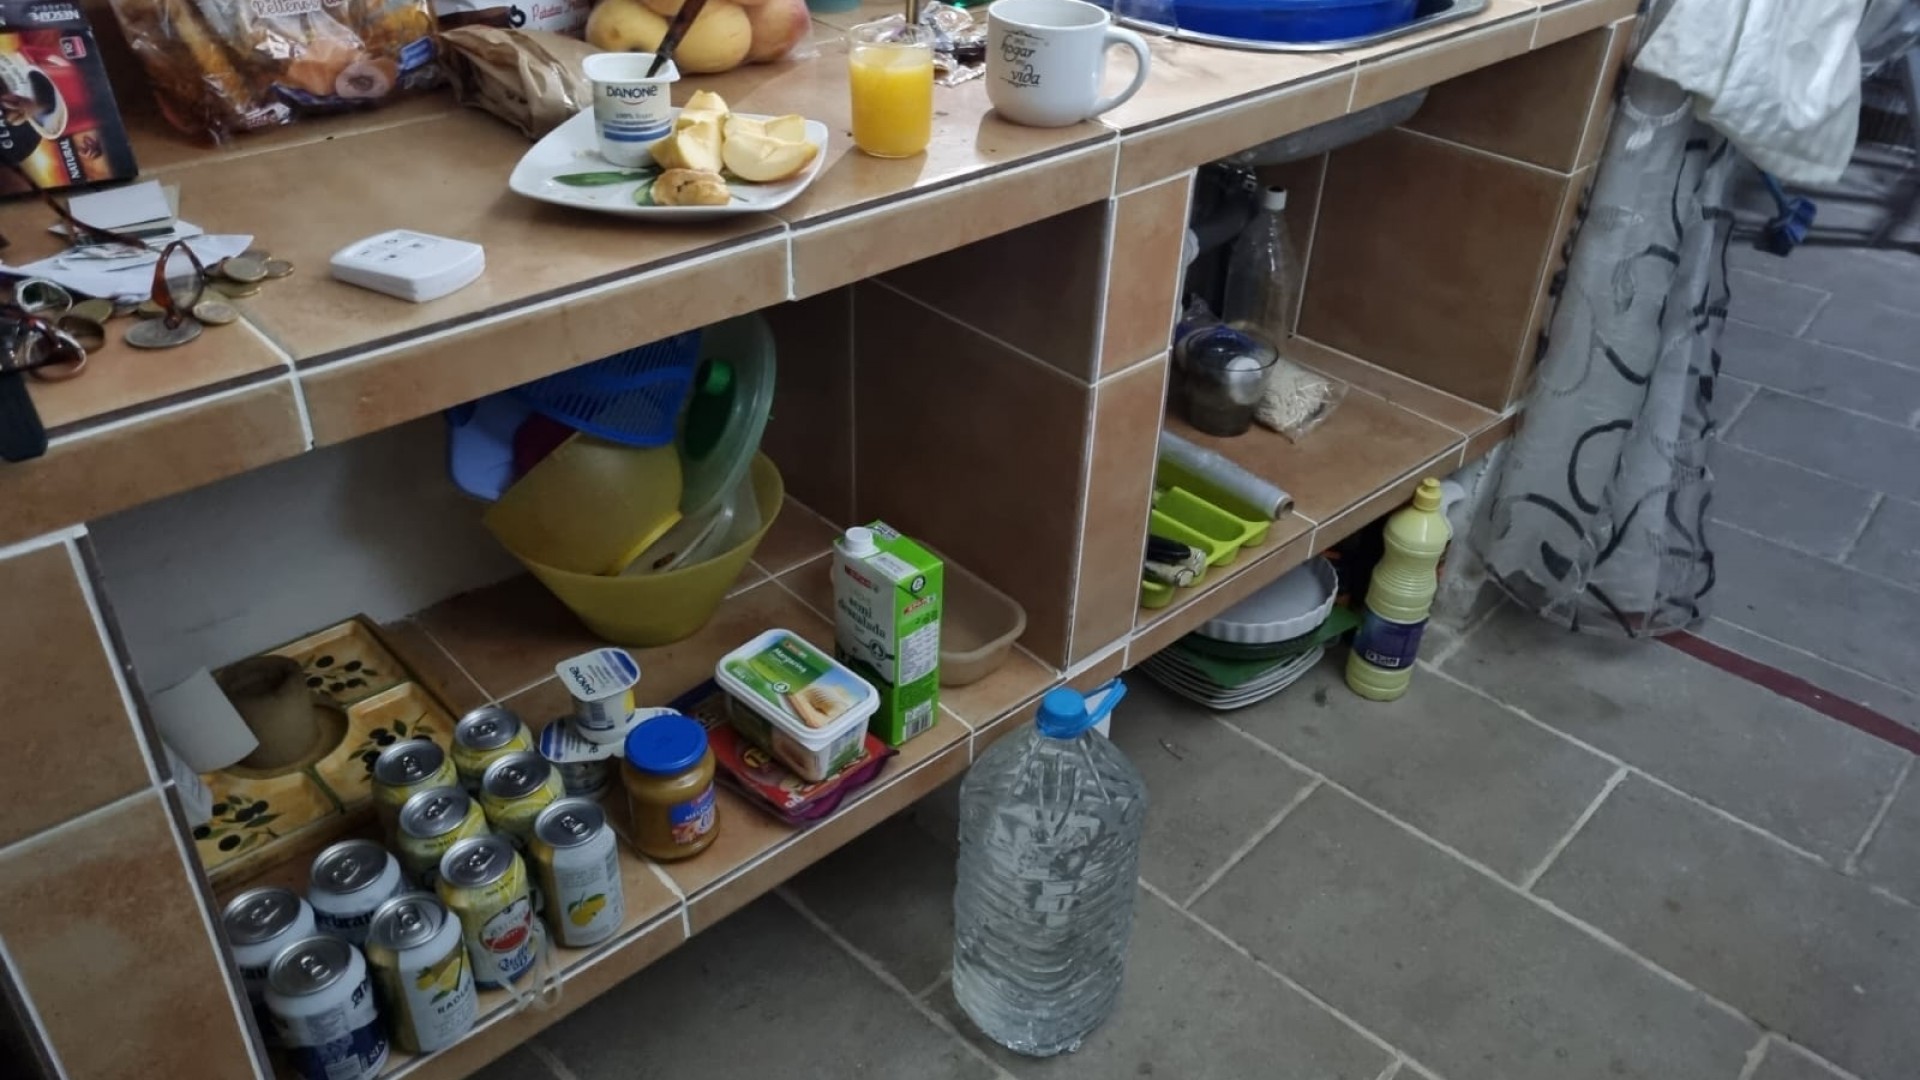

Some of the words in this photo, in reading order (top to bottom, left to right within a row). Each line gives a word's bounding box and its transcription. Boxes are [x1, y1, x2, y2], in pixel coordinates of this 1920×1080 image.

[1009, 63, 1041, 85] vida
[605, 84, 658, 99] DANONE
[59, 138, 82, 180] NATURAL
